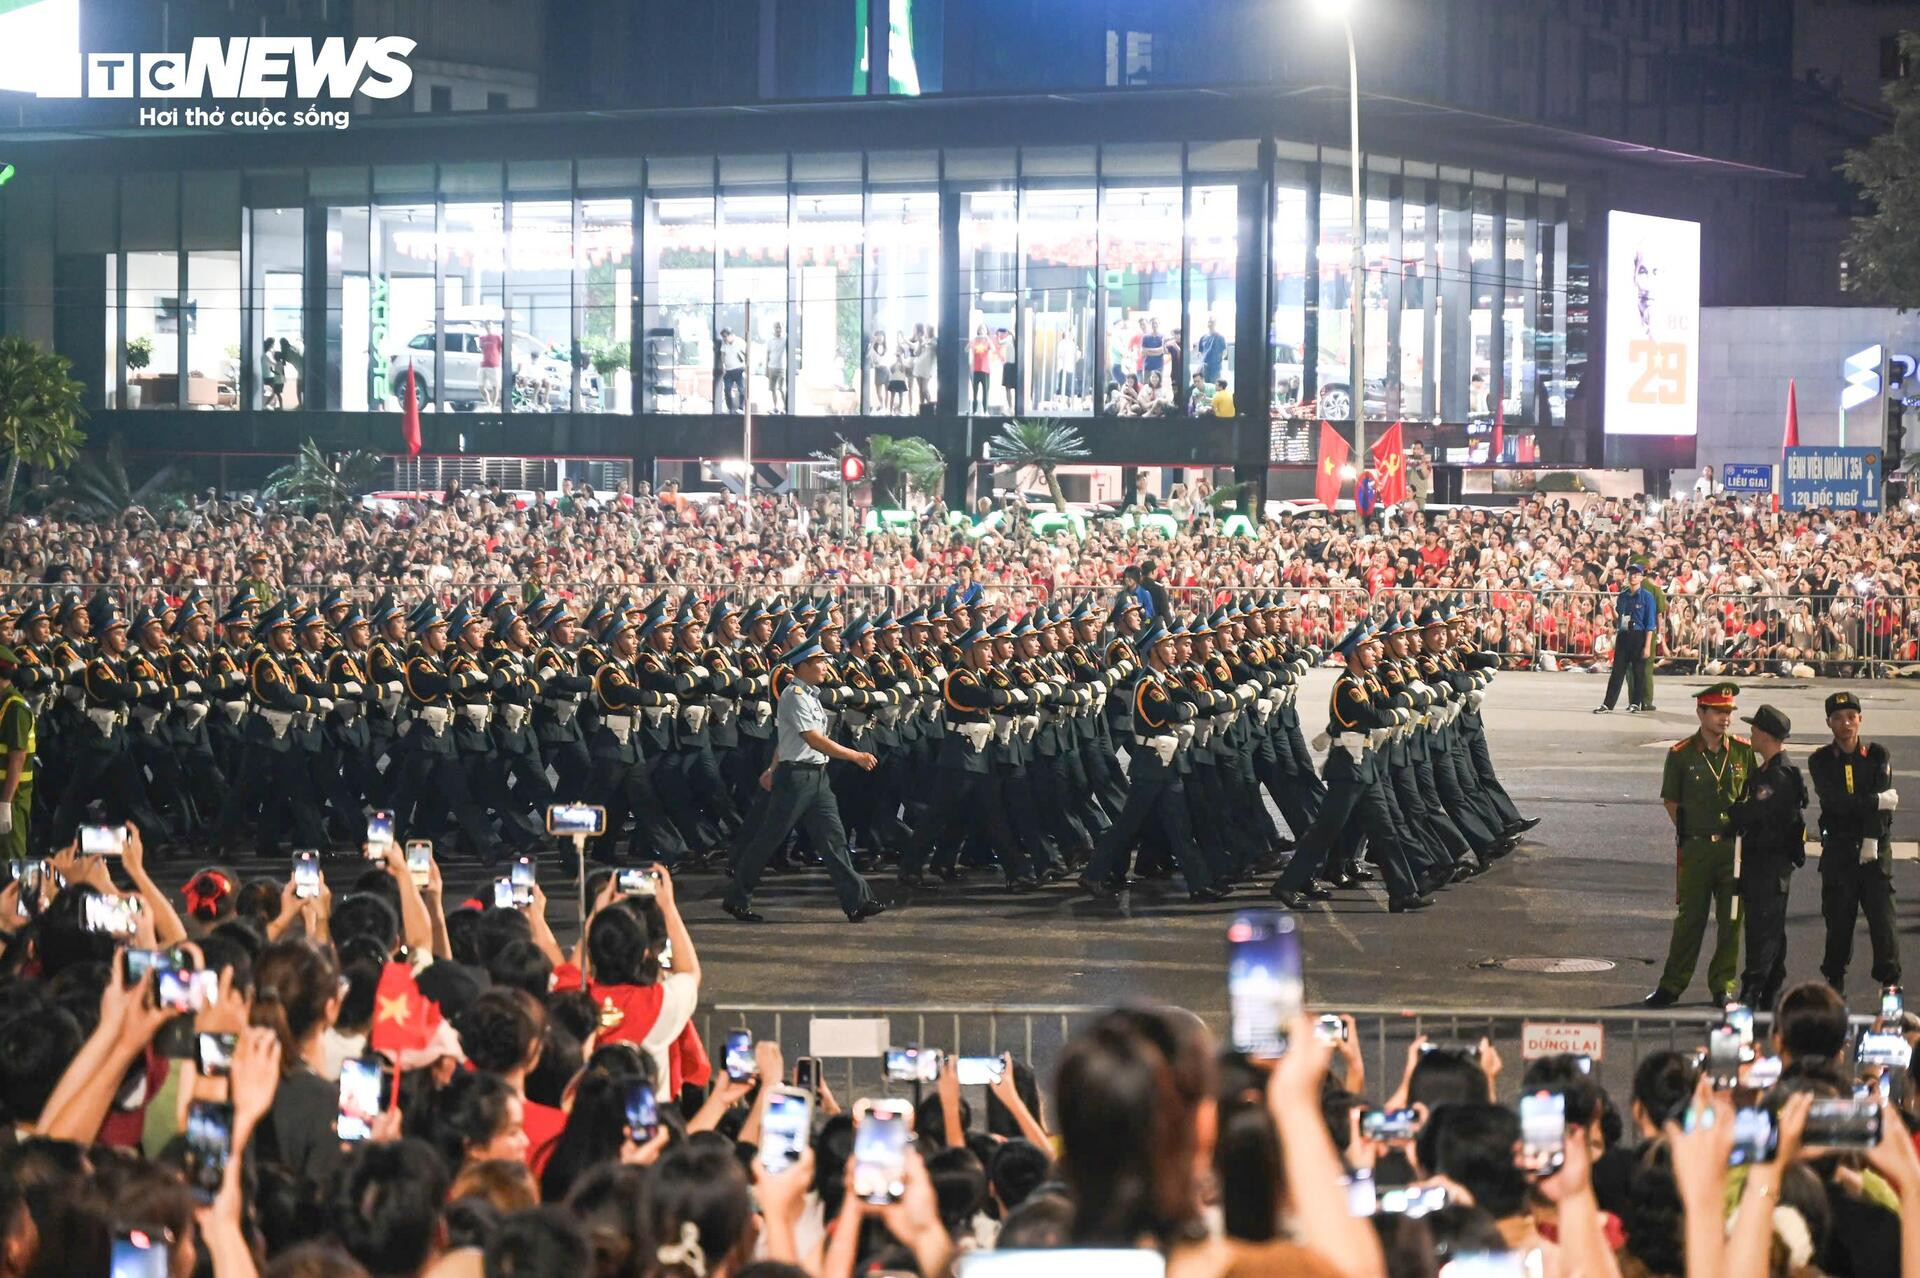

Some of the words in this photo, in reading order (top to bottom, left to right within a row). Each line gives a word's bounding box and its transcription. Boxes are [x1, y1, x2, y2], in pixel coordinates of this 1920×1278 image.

[1807, 451, 1823, 484] VIỆN
[1824, 451, 1843, 482] QUÂN
[1844, 456, 1849, 480] Y
[1749, 477, 1768, 488] GIAI
[1792, 491, 1810, 505] 120
